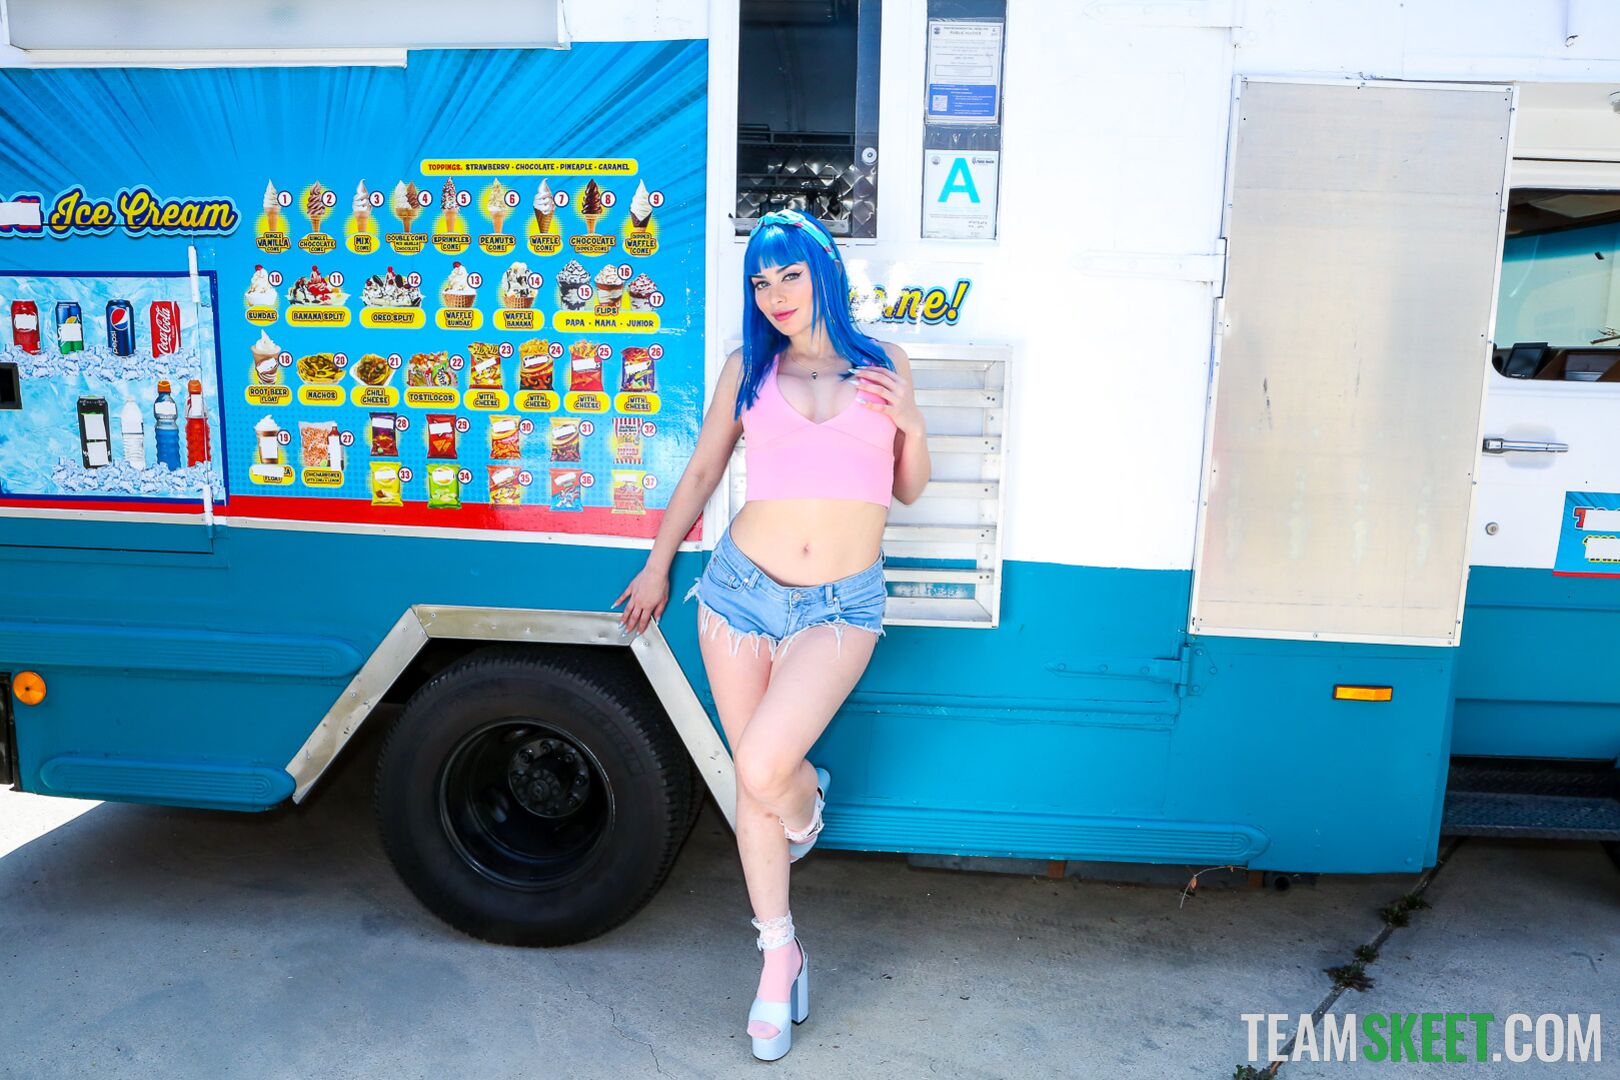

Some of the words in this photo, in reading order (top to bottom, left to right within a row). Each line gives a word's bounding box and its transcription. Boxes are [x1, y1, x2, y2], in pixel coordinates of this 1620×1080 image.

[465, 163, 510, 172] STRAWBERRY
[515, 163, 555, 172] CHOCOLATE
[598, 163, 630, 172] CARAMEL
[937, 157, 981, 204] A
[282, 194, 288, 204] 1
[326, 194, 332, 204] 2
[374, 194, 380, 204] 3
[422, 194, 428, 204] 4
[461, 194, 467, 204] 5
[509, 194, 515, 204] 6
[558, 194, 565, 204] 7
[605, 194, 612, 204] 8
[653, 194, 660, 204] 9
[49, 189, 115, 232] Ice
[119, 189, 236, 231] Cream
[257, 238, 290, 248] VANILLA
[356, 237, 370, 245] MIX
[531, 236, 559, 244] WAFFLE
[626, 239, 656, 248] WAFFLE
[619, 267, 630, 276] 16
[270, 274, 280, 284] 10
[332, 276, 341, 284] 11
[410, 276, 420, 285] 12
[470, 276, 480, 285] 13
[530, 276, 540, 285] 14
[580, 288, 590, 297] 15
[651, 295, 661, 304] 17
[504, 312, 532, 320] WAFFLE
[565, 319, 585, 327] PAPA
[594, 319, 616, 327] MAMA
[626, 319, 654, 328] JUNIOR
[502, 345, 512, 355] 23
[551, 345, 561, 355] 24
[599, 347, 609, 356] 25
[651, 347, 661, 356] 26
[280, 355, 290, 364] 18
[335, 355, 345, 365] 20
[390, 356, 399, 366] 21
[452, 358, 462, 367] 22
[409, 393, 454, 401] TOSTILOCOS
[397, 419, 407, 428] 28
[457, 420, 467, 430] 29
[522, 422, 532, 431] 30
[582, 424, 592, 433] 31
[644, 425, 655, 434] 32
[279, 434, 289, 442] 19
[342, 434, 352, 443] 27
[400, 470, 410, 479] 33
[460, 471, 470, 480] 34
[520, 474, 530, 483] 35
[581, 475, 591, 484] 36
[645, 477, 655, 486] 37
